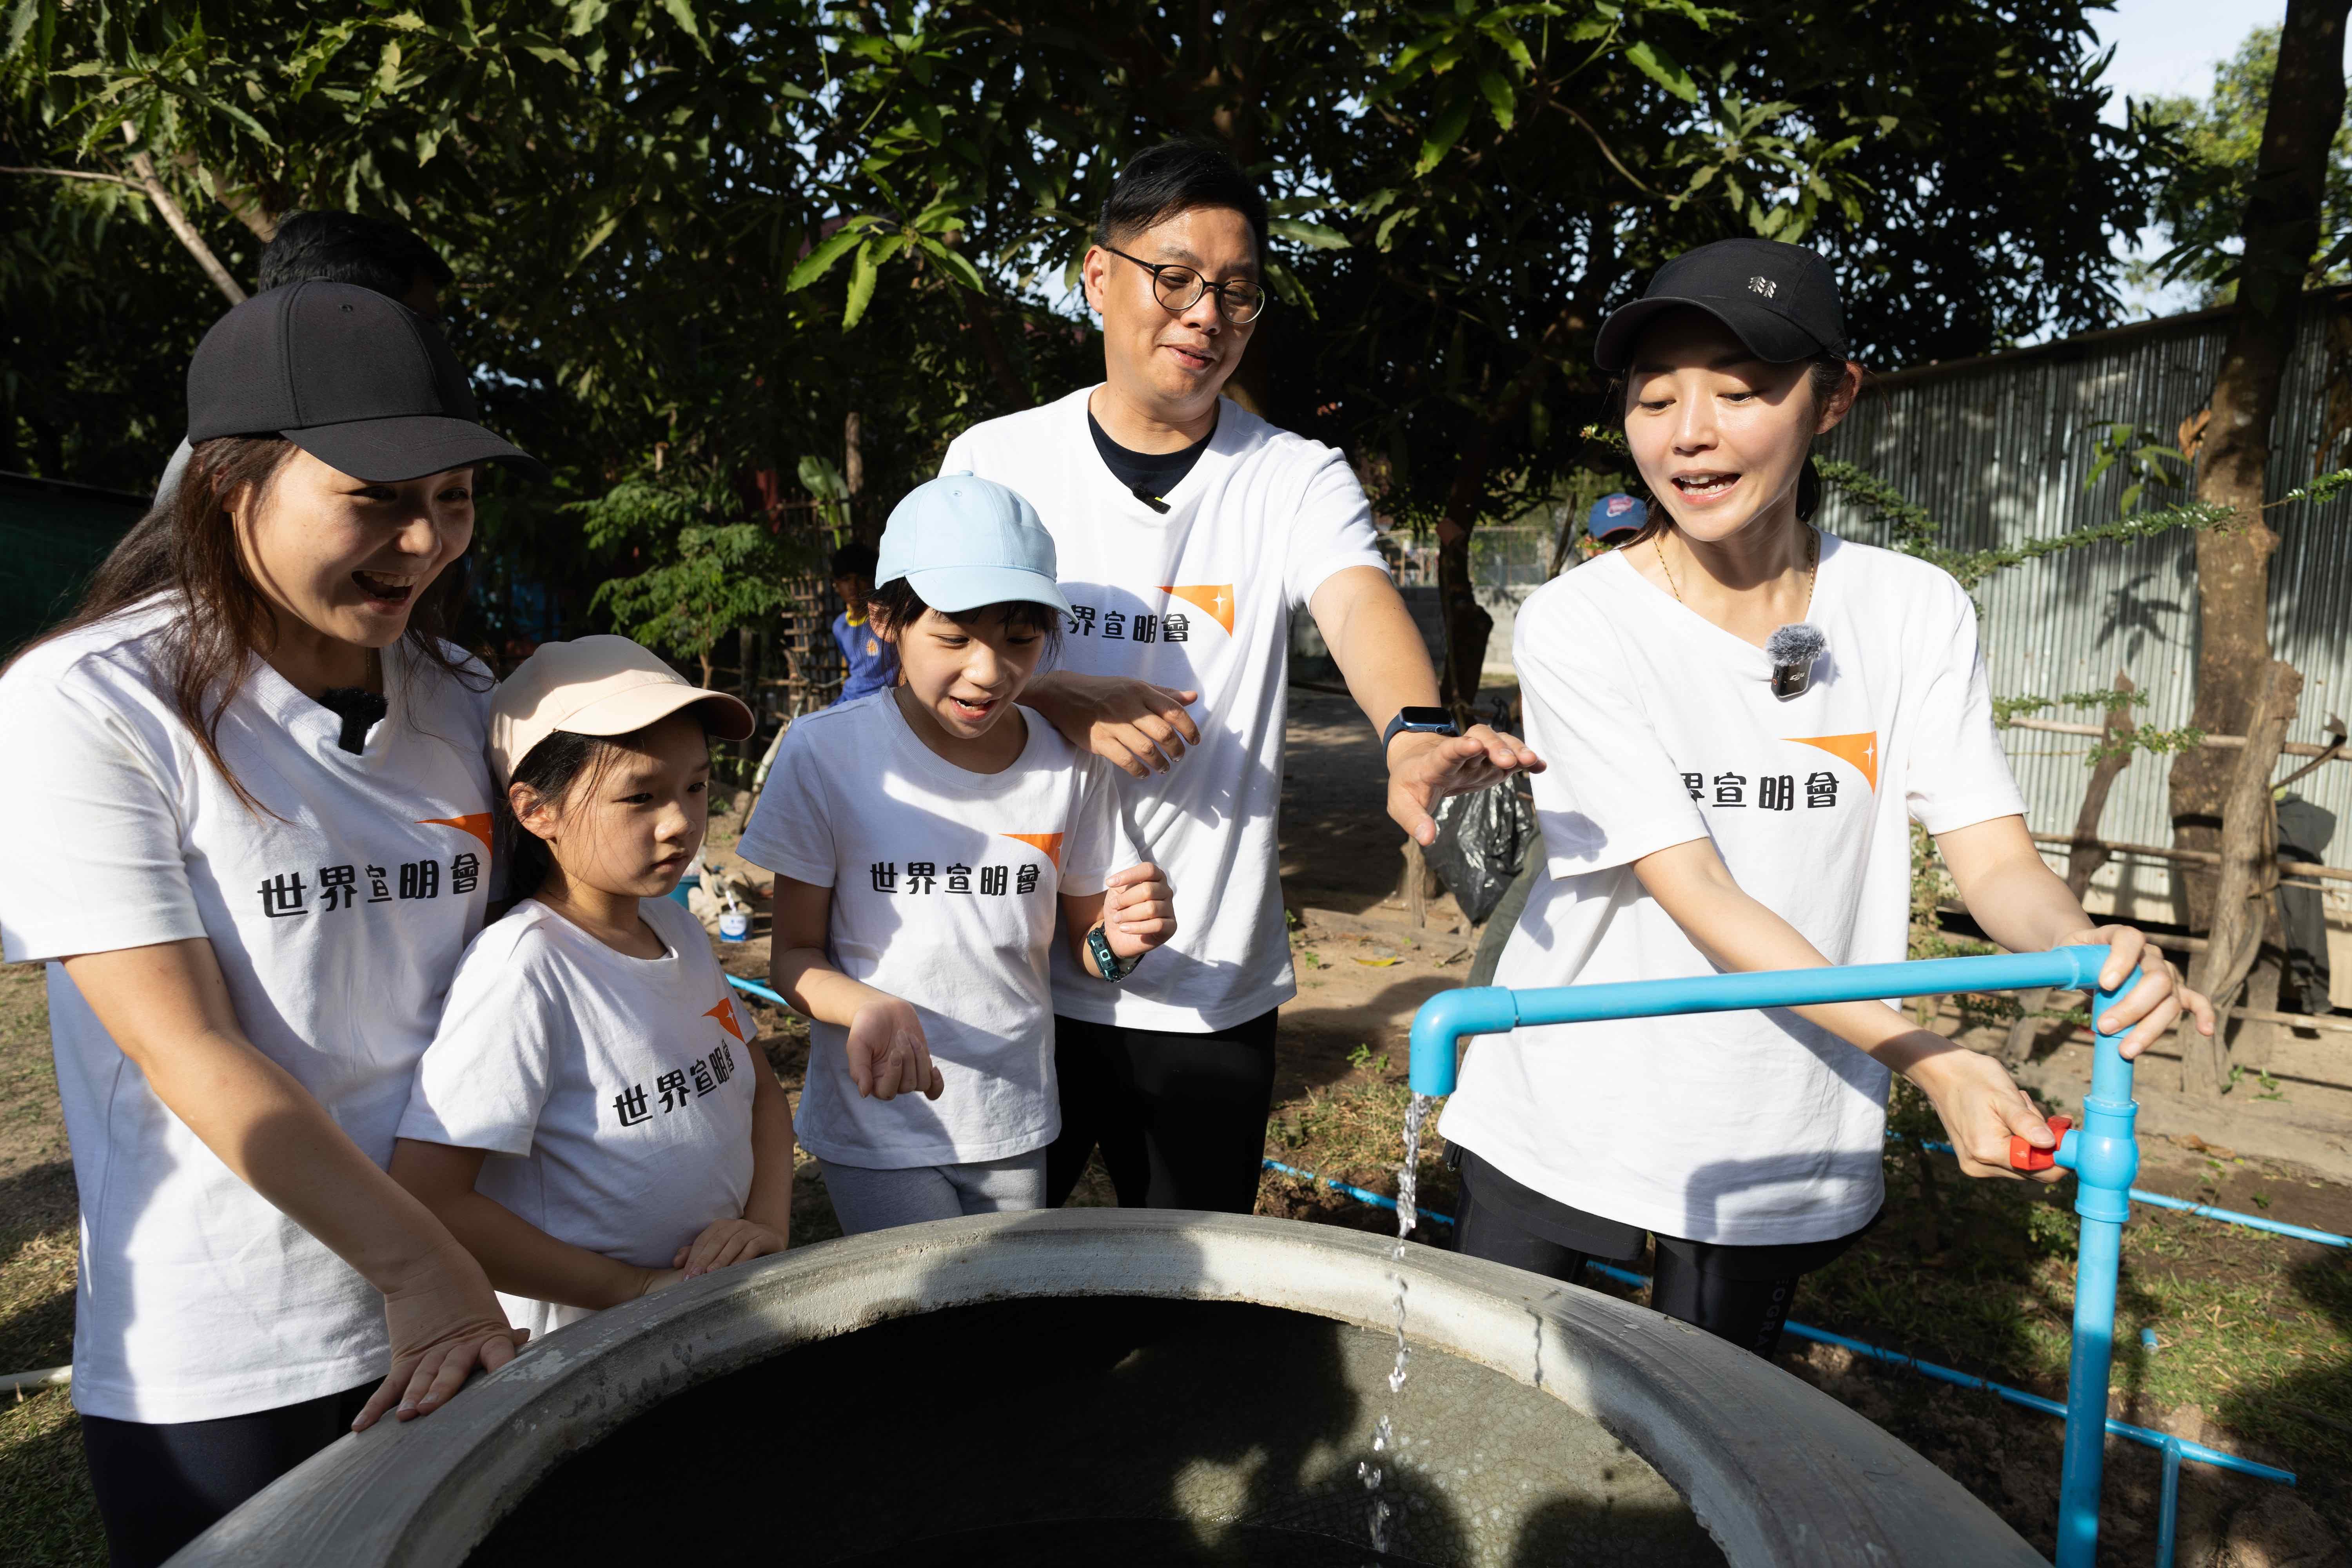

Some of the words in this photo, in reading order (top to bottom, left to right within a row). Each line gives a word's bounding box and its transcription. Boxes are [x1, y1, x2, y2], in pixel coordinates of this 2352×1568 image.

[257, 853, 480, 918] 世界宣明會
[869, 862, 1040, 896] 世界宣明會
[613, 1038, 735, 1127] 世界宣明會
